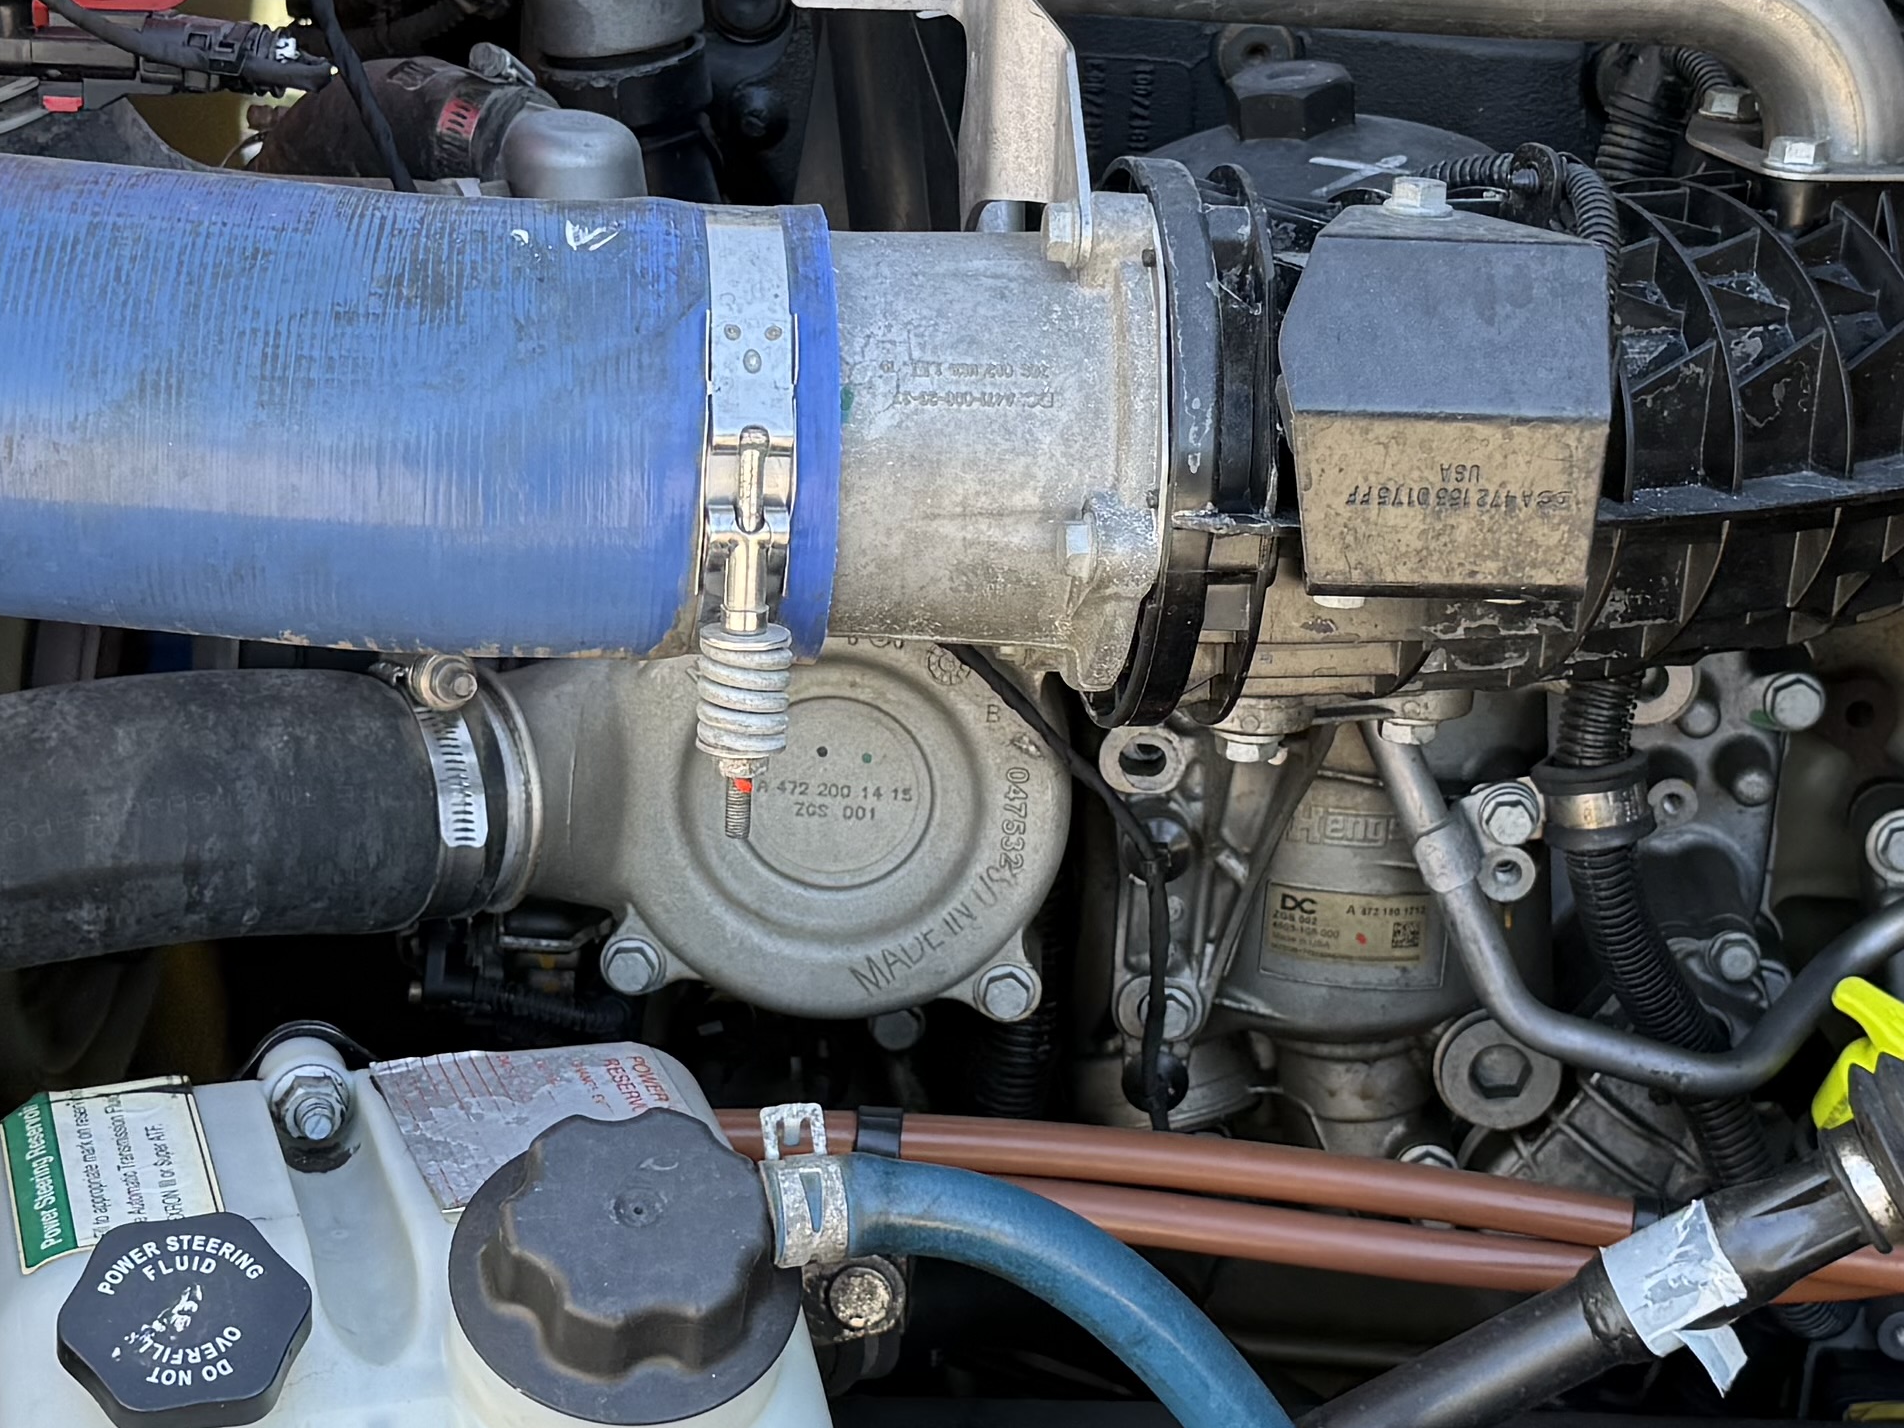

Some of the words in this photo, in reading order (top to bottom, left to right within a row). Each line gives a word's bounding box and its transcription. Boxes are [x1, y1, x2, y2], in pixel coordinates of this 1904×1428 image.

[1439, 462, 1481, 483] USA
[986, 704, 1001, 725] B
[776, 780, 809, 797] 472
[817, 782, 852, 799] 200
[861, 786, 884, 801] 14
[892, 787, 913, 802] 15
[842, 805, 877, 821] 001
[999, 767, 1031, 871] 047532
[1280, 893, 1317, 915] DC
[1346, 905, 1356, 916] A
[849, 928, 944, 998] MADE
[943, 902, 978, 936] IN
[602, 1057, 648, 1113] RESERV
[626, 1054, 670, 1105] POWER
[76, 1127, 92, 1139] on
[110, 1113, 137, 1171] Transmission
[29, 1155, 57, 1213] Steering
[122, 1169, 148, 1217] Automatic
[39, 1212, 64, 1252] Power
[97, 1241, 161, 1296] POWER
[165, 1234, 266, 1280] STEERING
[142, 1255, 217, 1282] FLUID
[138, 1326, 242, 1365] OVERFILL
[146, 1366, 193, 1387] NOT
[201, 1358, 234, 1382] DO
